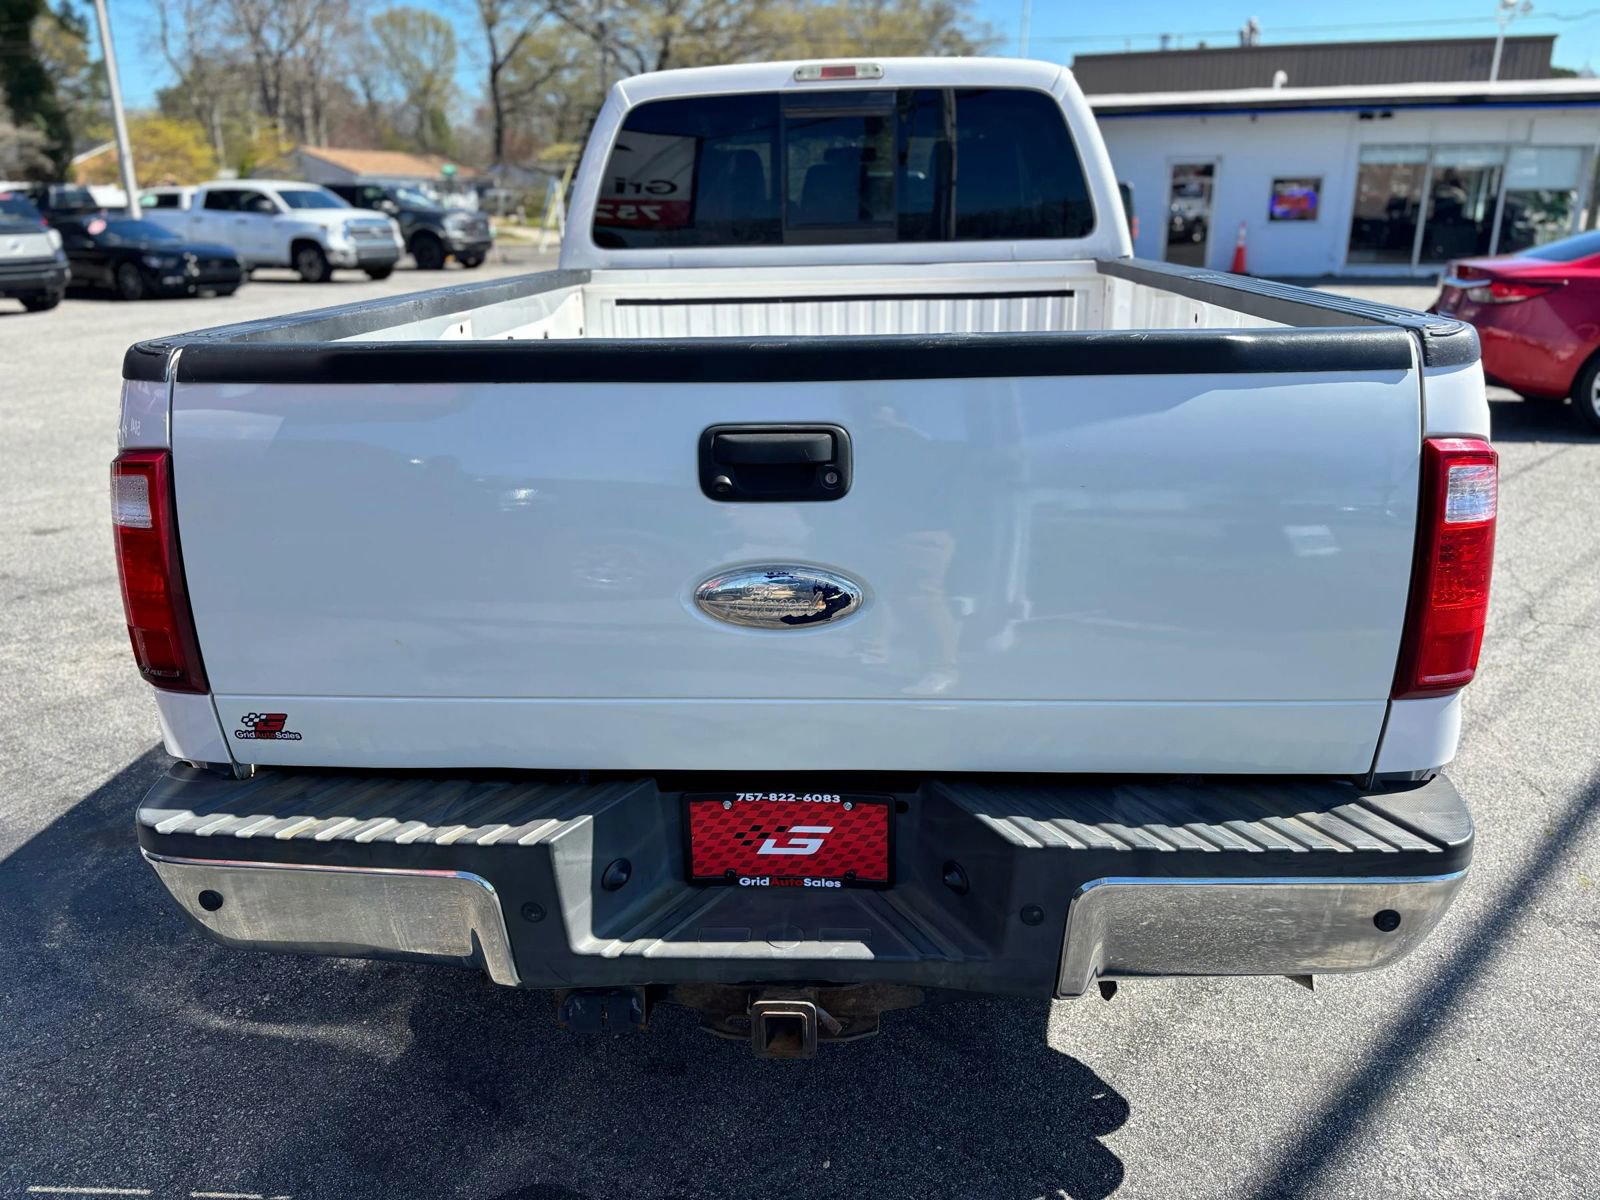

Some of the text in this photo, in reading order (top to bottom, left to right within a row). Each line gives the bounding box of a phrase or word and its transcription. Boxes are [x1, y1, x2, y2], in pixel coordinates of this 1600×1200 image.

[235, 730, 301, 740] GridAutoSales
[735, 793, 841, 803] 757-822-6083
[738, 877, 842, 888] GridAutoSales
